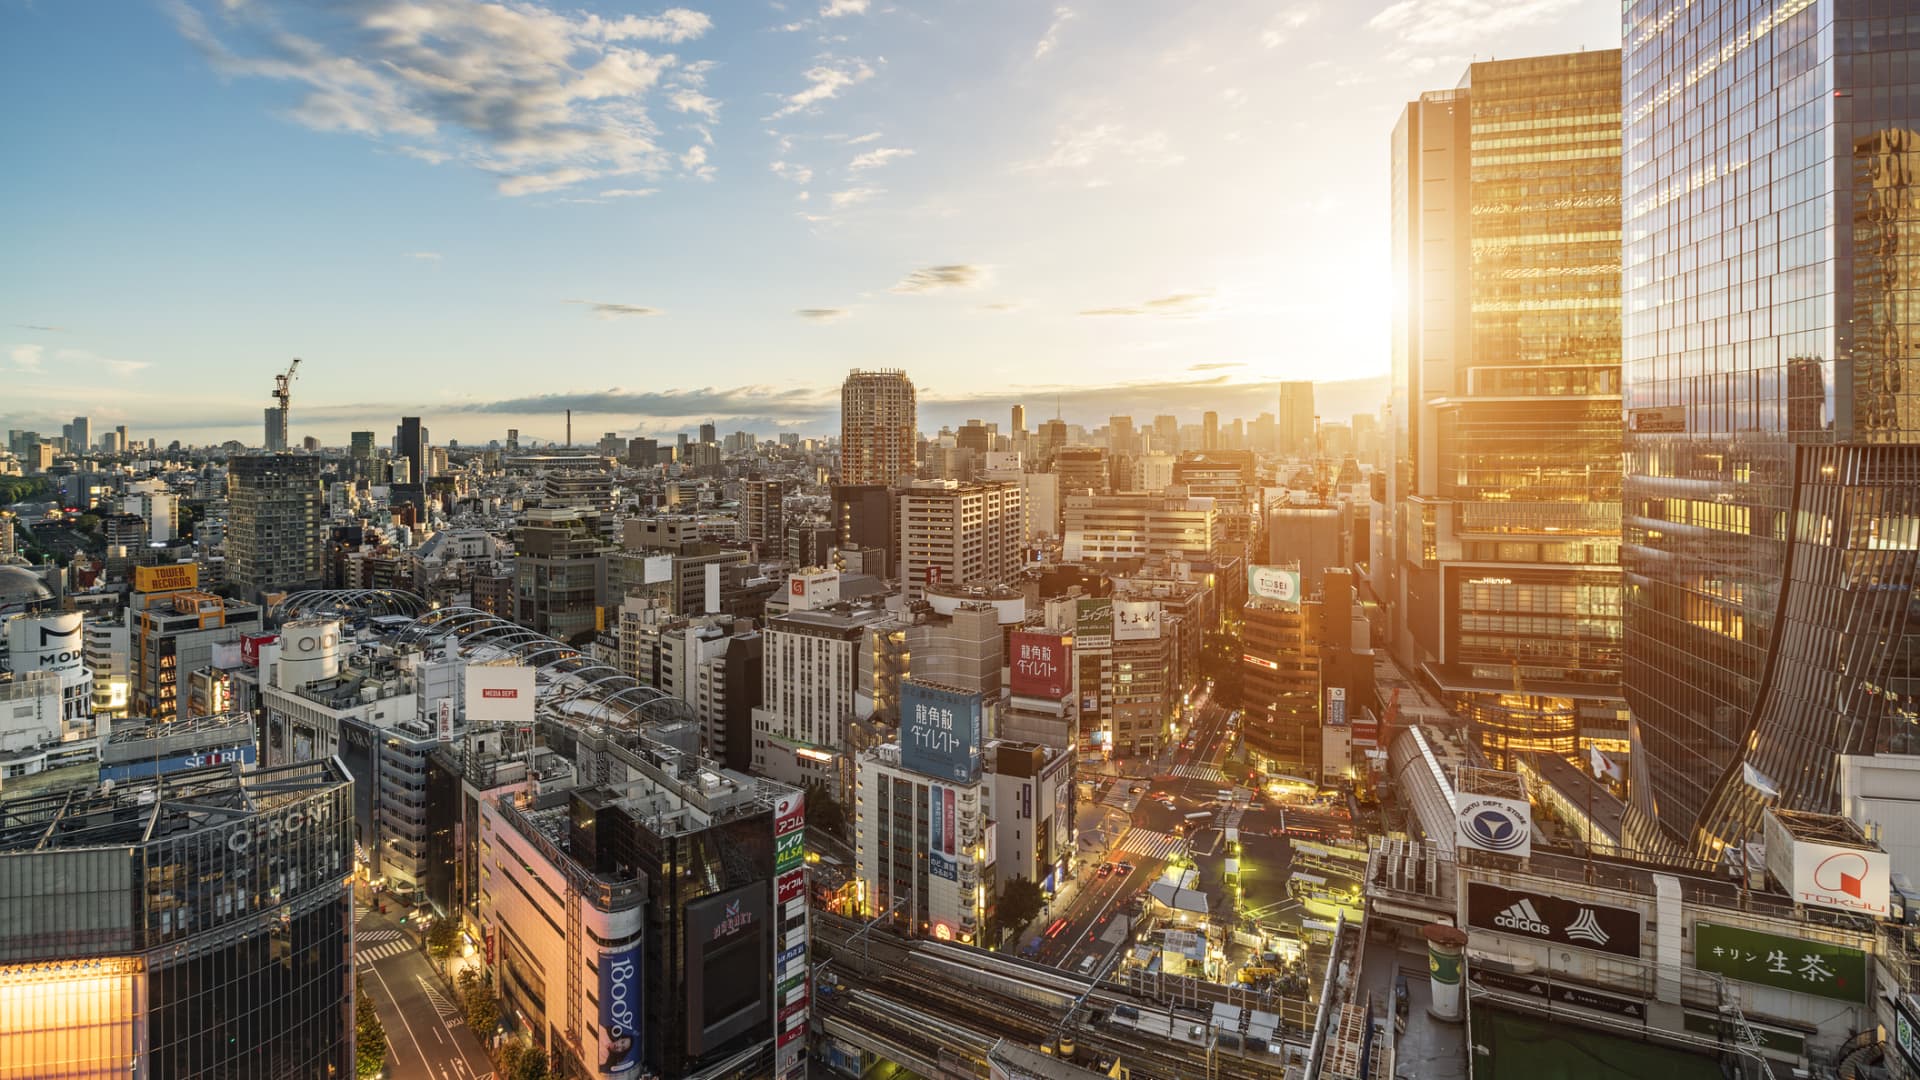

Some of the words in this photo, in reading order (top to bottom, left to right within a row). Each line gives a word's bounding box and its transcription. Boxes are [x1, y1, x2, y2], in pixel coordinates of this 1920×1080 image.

[152, 576, 192, 589] RECORDS
[155, 567, 185, 578] TOWER
[915, 704, 953, 730] 龍角散
[910, 725, 960, 753] ダイレクト
[1461, 802, 1480, 816] TOKYU
[1506, 806, 1527, 825] STORE
[778, 815, 804, 833] アコム
[777, 832, 803, 852] レイク
[1494, 915, 1551, 935] adidas
[1712, 946, 1757, 962] キリン
[1766, 950, 1834, 982] 生茶
